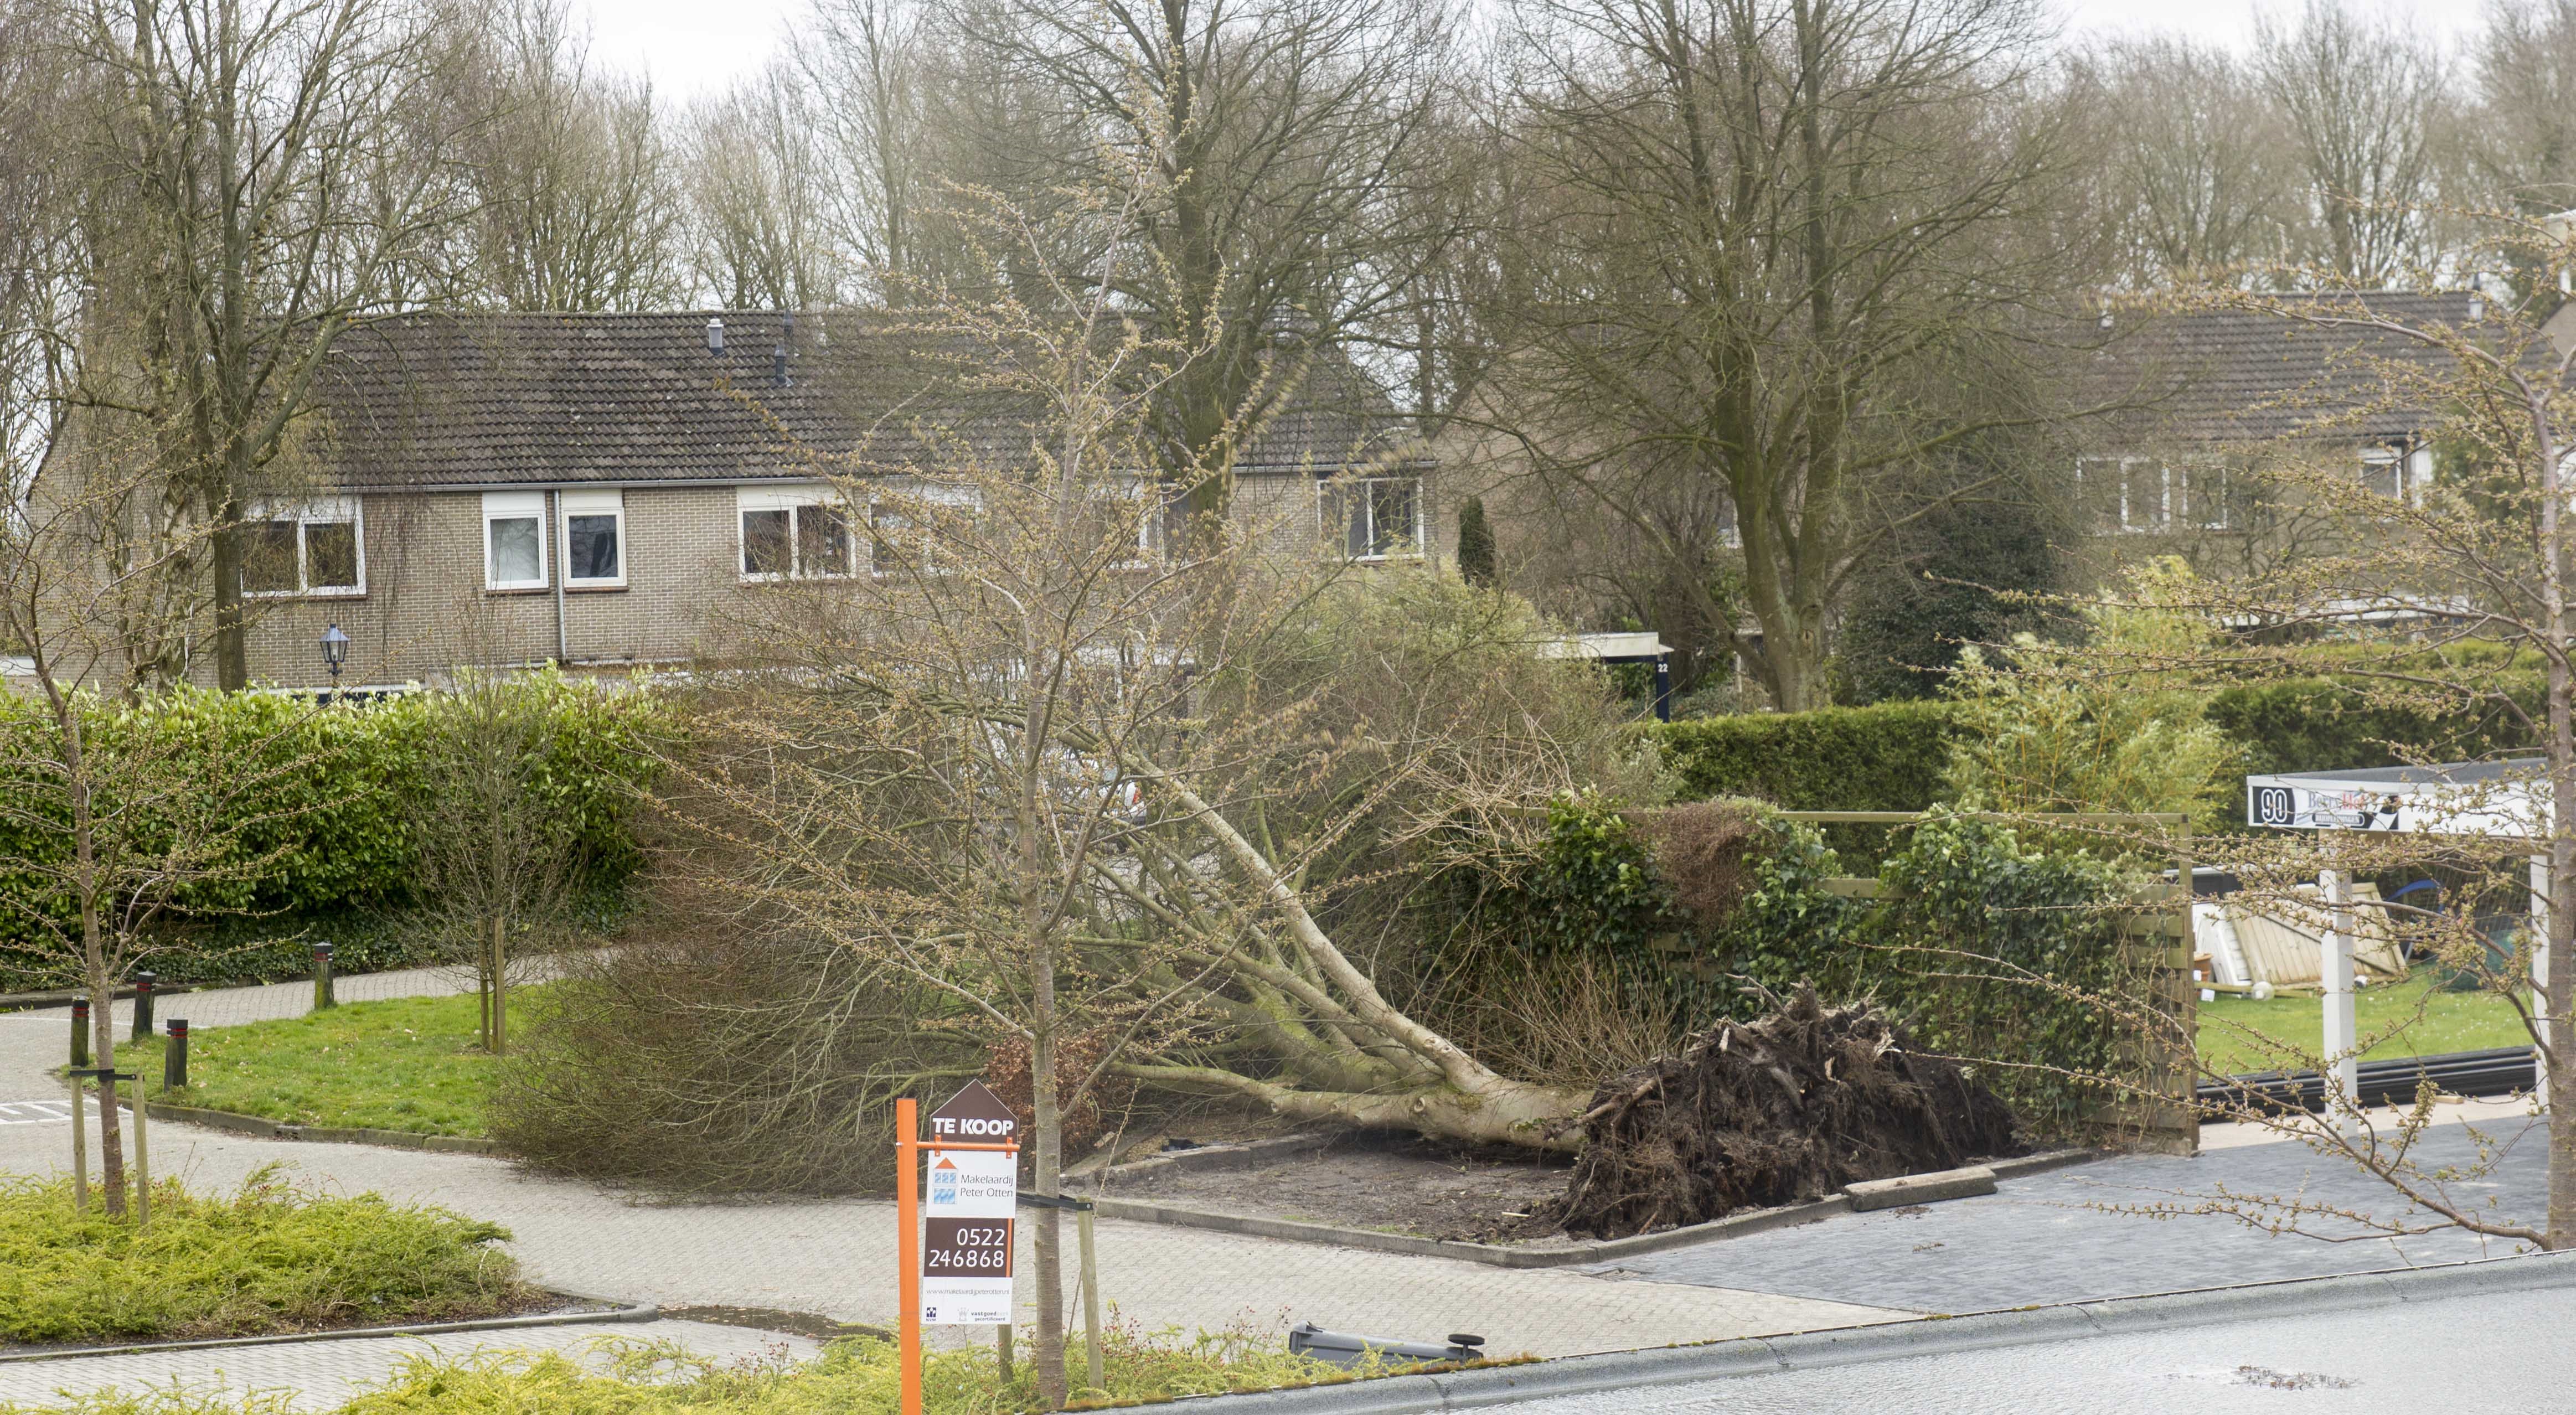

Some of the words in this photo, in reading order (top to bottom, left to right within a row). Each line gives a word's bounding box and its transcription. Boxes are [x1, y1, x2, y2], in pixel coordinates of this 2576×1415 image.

[1658, 663, 1668, 673] 22
[2261, 789, 2288, 822] 90
[2342, 792, 2366, 809] Ho
[932, 1118, 956, 1134] TE
[960, 1119, 1014, 1135] KOOP
[961, 1174, 1014, 1186] Makelaardij
[960, 1187, 985, 1196] Peter
[987, 1188, 1013, 1197] Otten
[957, 1228, 1005, 1246] 0522
[928, 1249, 1004, 1268] 246868
